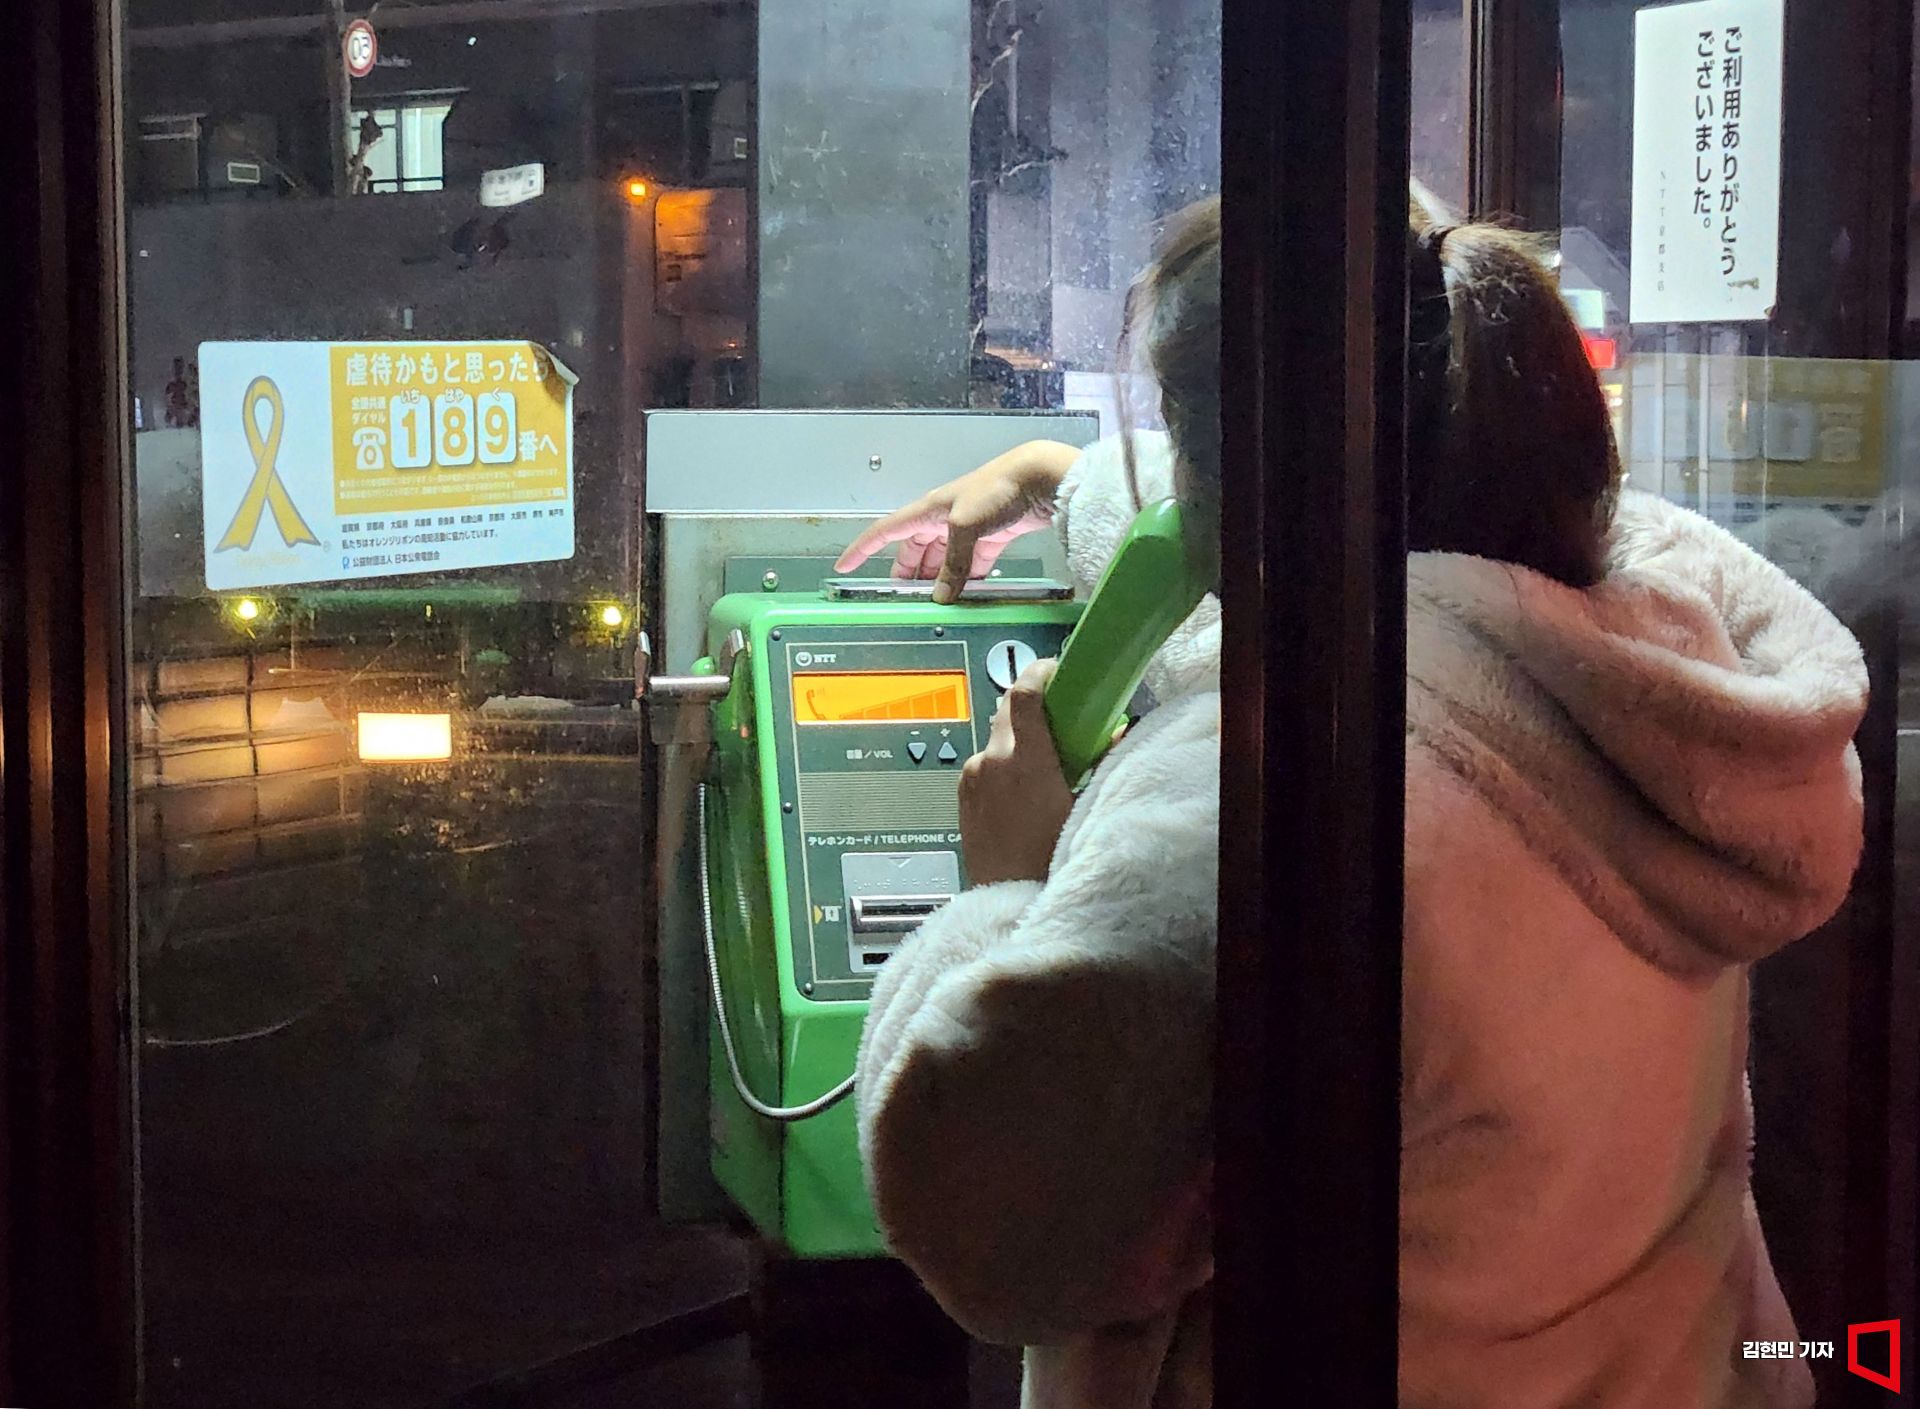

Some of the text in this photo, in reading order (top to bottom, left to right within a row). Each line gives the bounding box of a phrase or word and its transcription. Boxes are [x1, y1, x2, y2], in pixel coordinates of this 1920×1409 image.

[1693, 31, 1715, 229] ございました。
[1720, 26, 1743, 275] ご利用ありがとう
[880, 832, 945, 844] TELEPHONE
